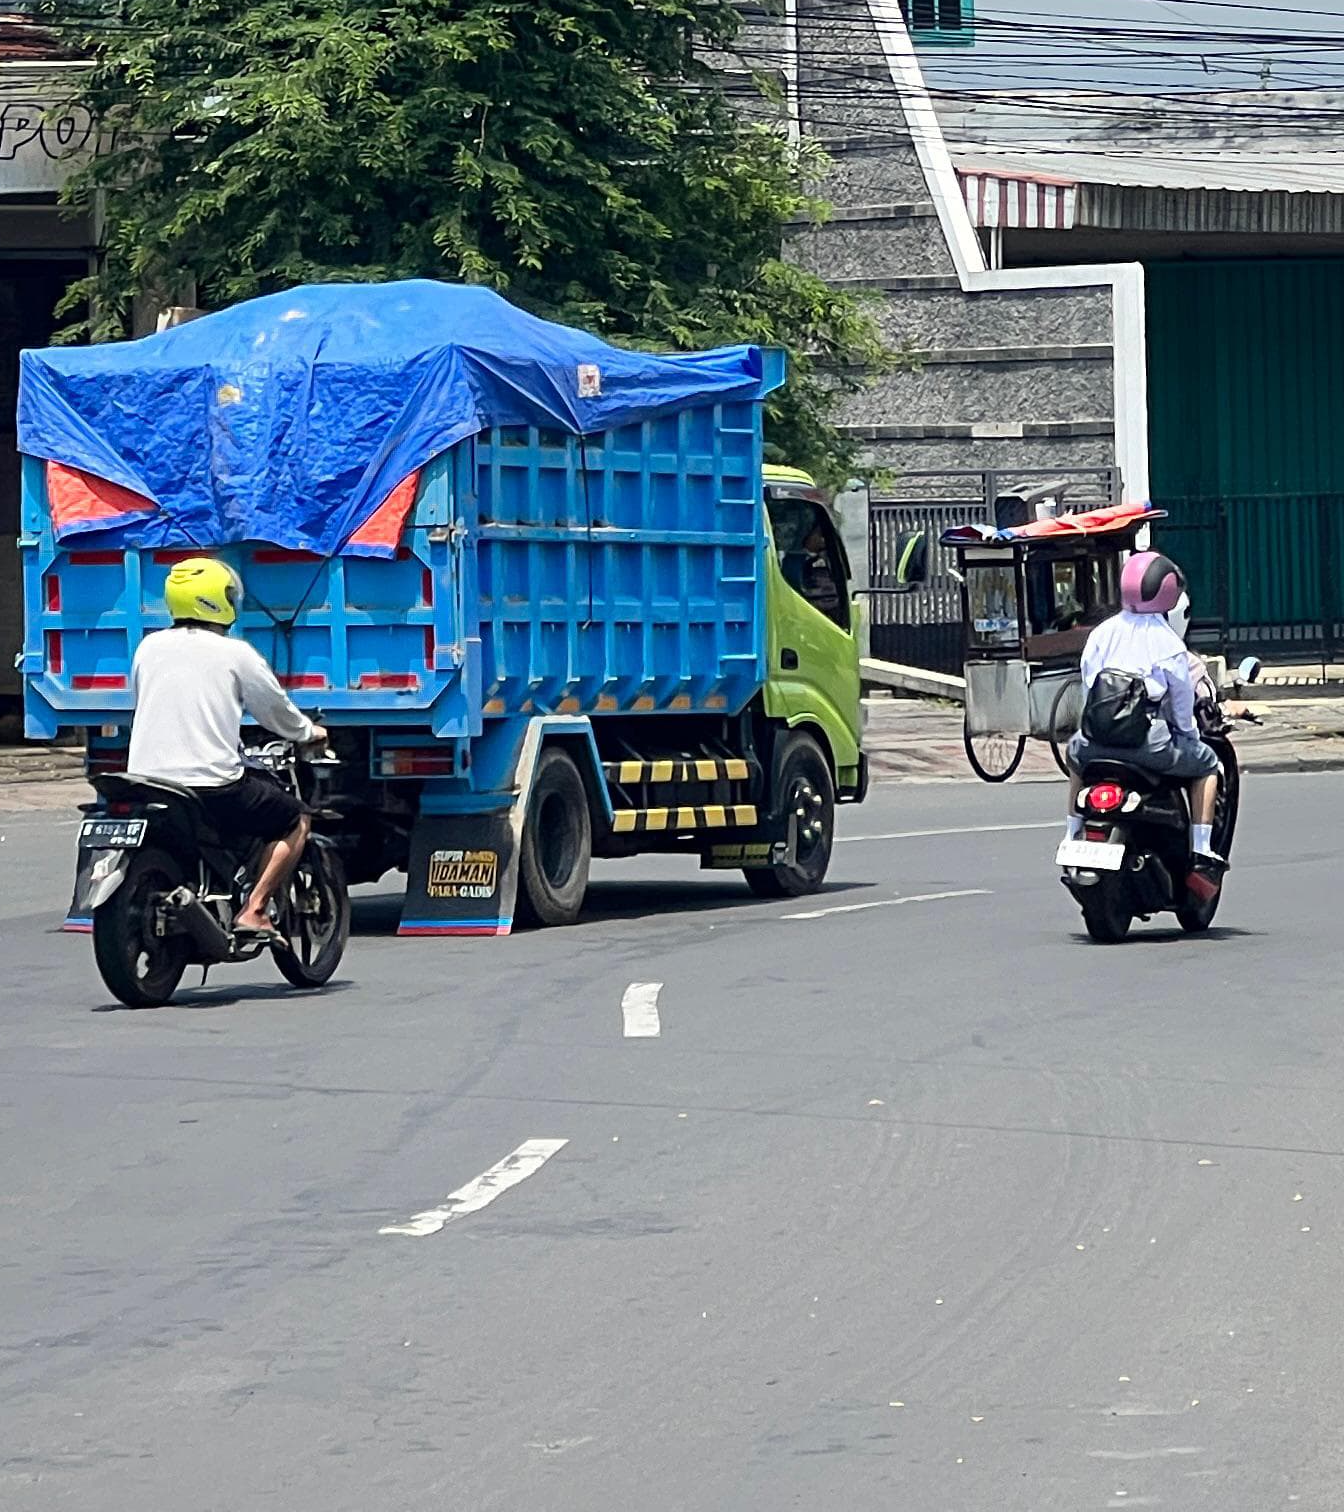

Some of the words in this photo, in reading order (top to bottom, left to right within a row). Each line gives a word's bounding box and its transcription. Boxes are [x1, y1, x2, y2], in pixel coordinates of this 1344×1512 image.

[432, 862, 494, 885] IDAMAN
[430, 886, 457, 897] PARA
[460, 886, 493, 898] GADIS
